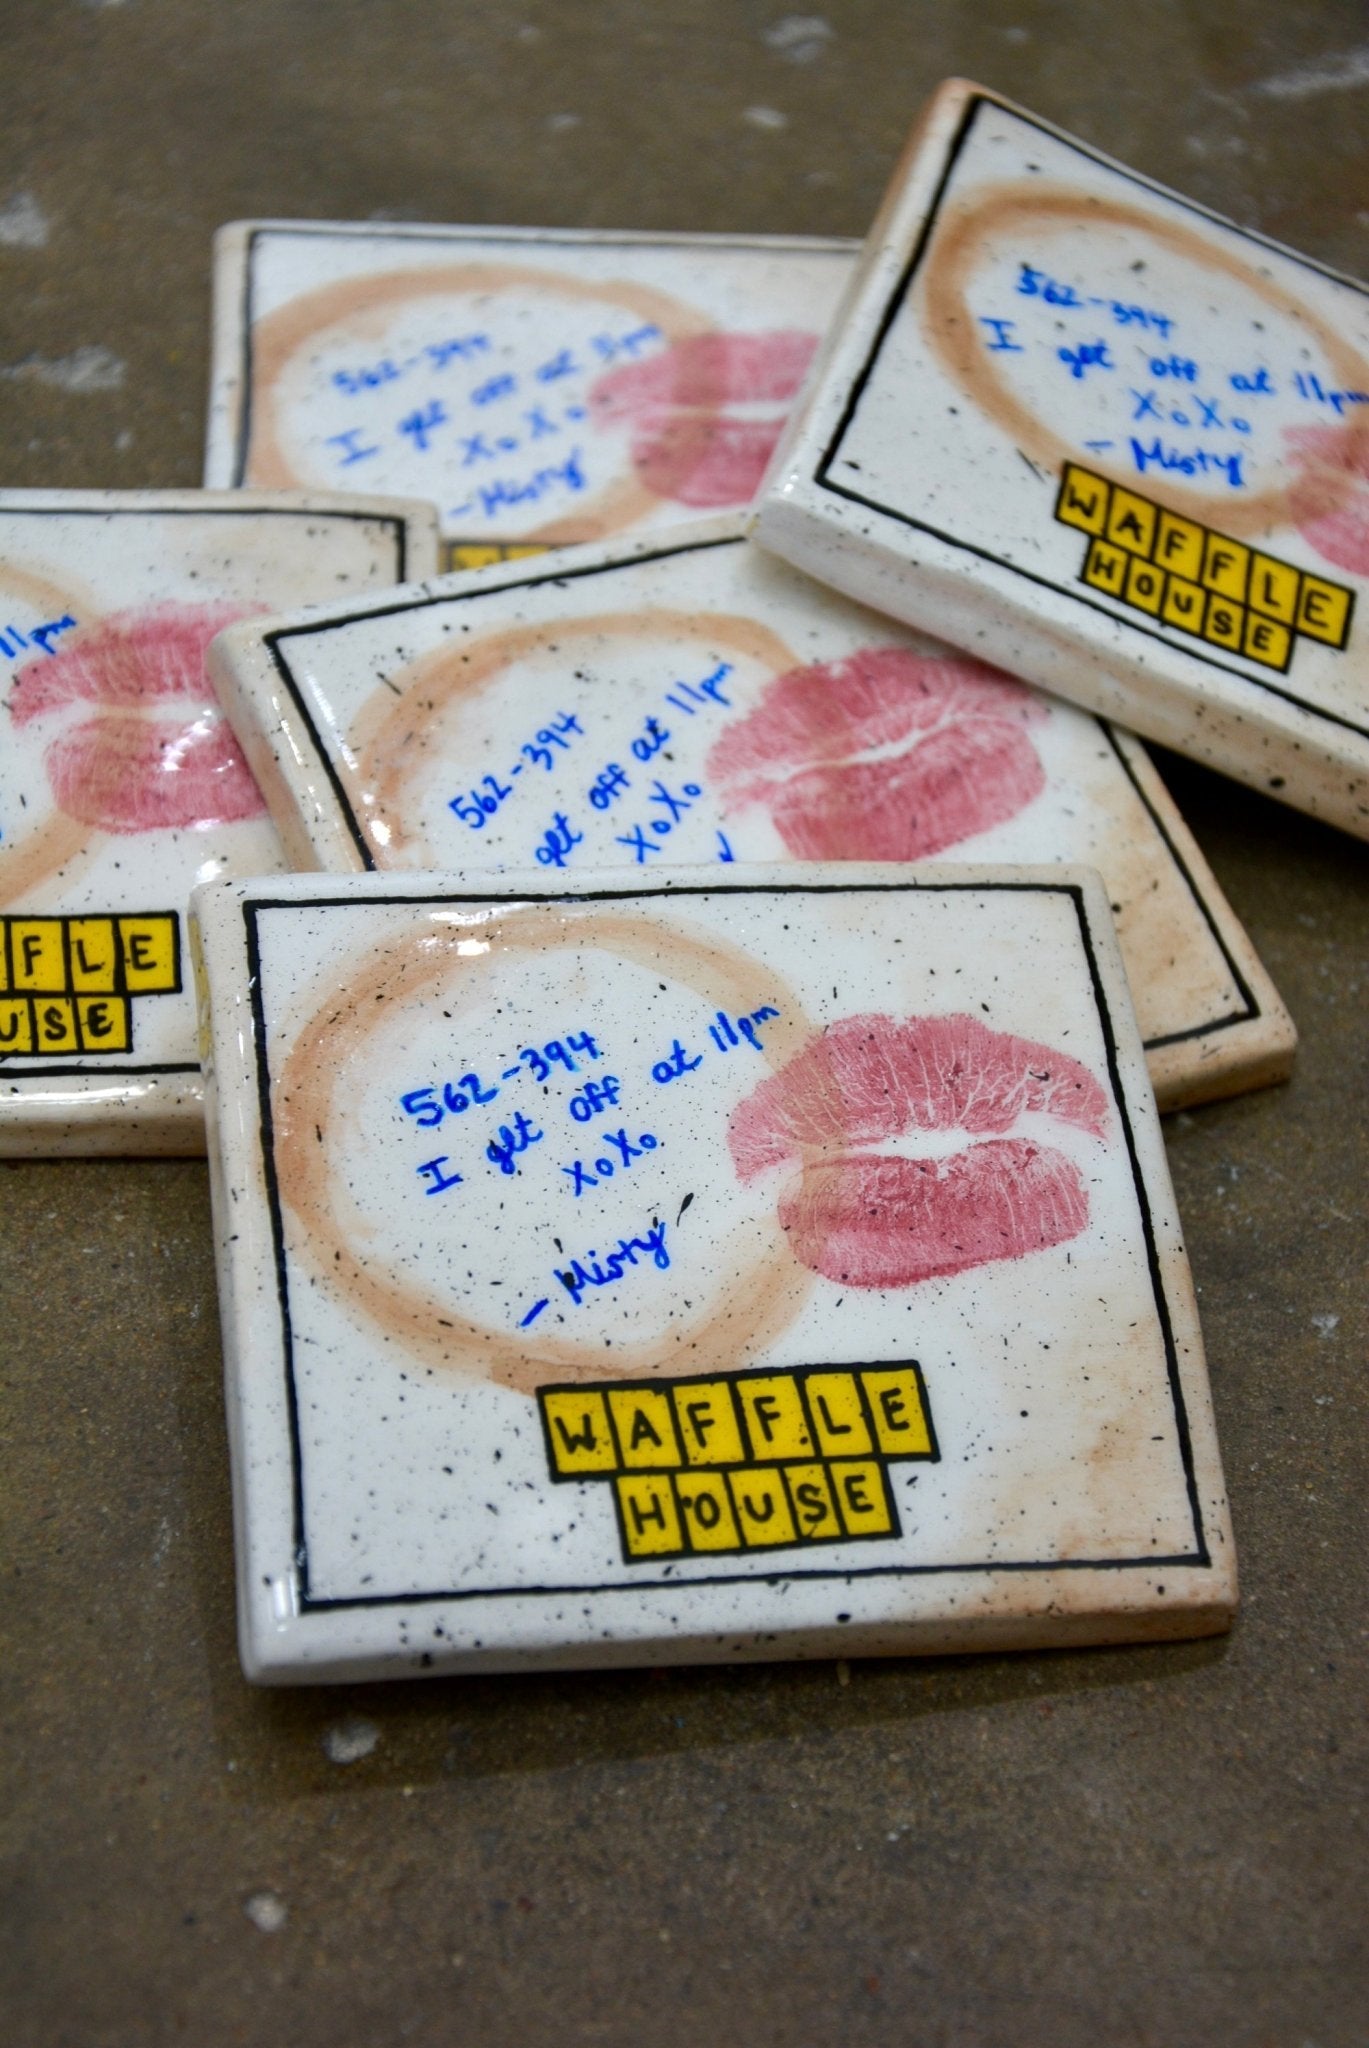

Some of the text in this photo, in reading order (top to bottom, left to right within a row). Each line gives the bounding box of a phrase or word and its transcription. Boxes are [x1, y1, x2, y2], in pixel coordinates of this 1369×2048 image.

[982, 318, 1023, 352] I
[1056, 341, 1114, 381] get
[1148, 355, 1199, 384] off
[1228, 368, 1275, 395] at
[1064, 486, 1334, 631] WAFFLE
[1089, 551, 1275, 653] HOUSE
[448, 713, 583, 831] 562-394
[588, 763, 631, 812] off
[630, 716, 672, 764] at
[400, 1030, 601, 1129] 562-394
[416, 1007, 778, 1197] I get off at 11pm
[553, 1386, 913, 1456] WAFFLE
[627, 1473, 875, 1537] HOUSE
